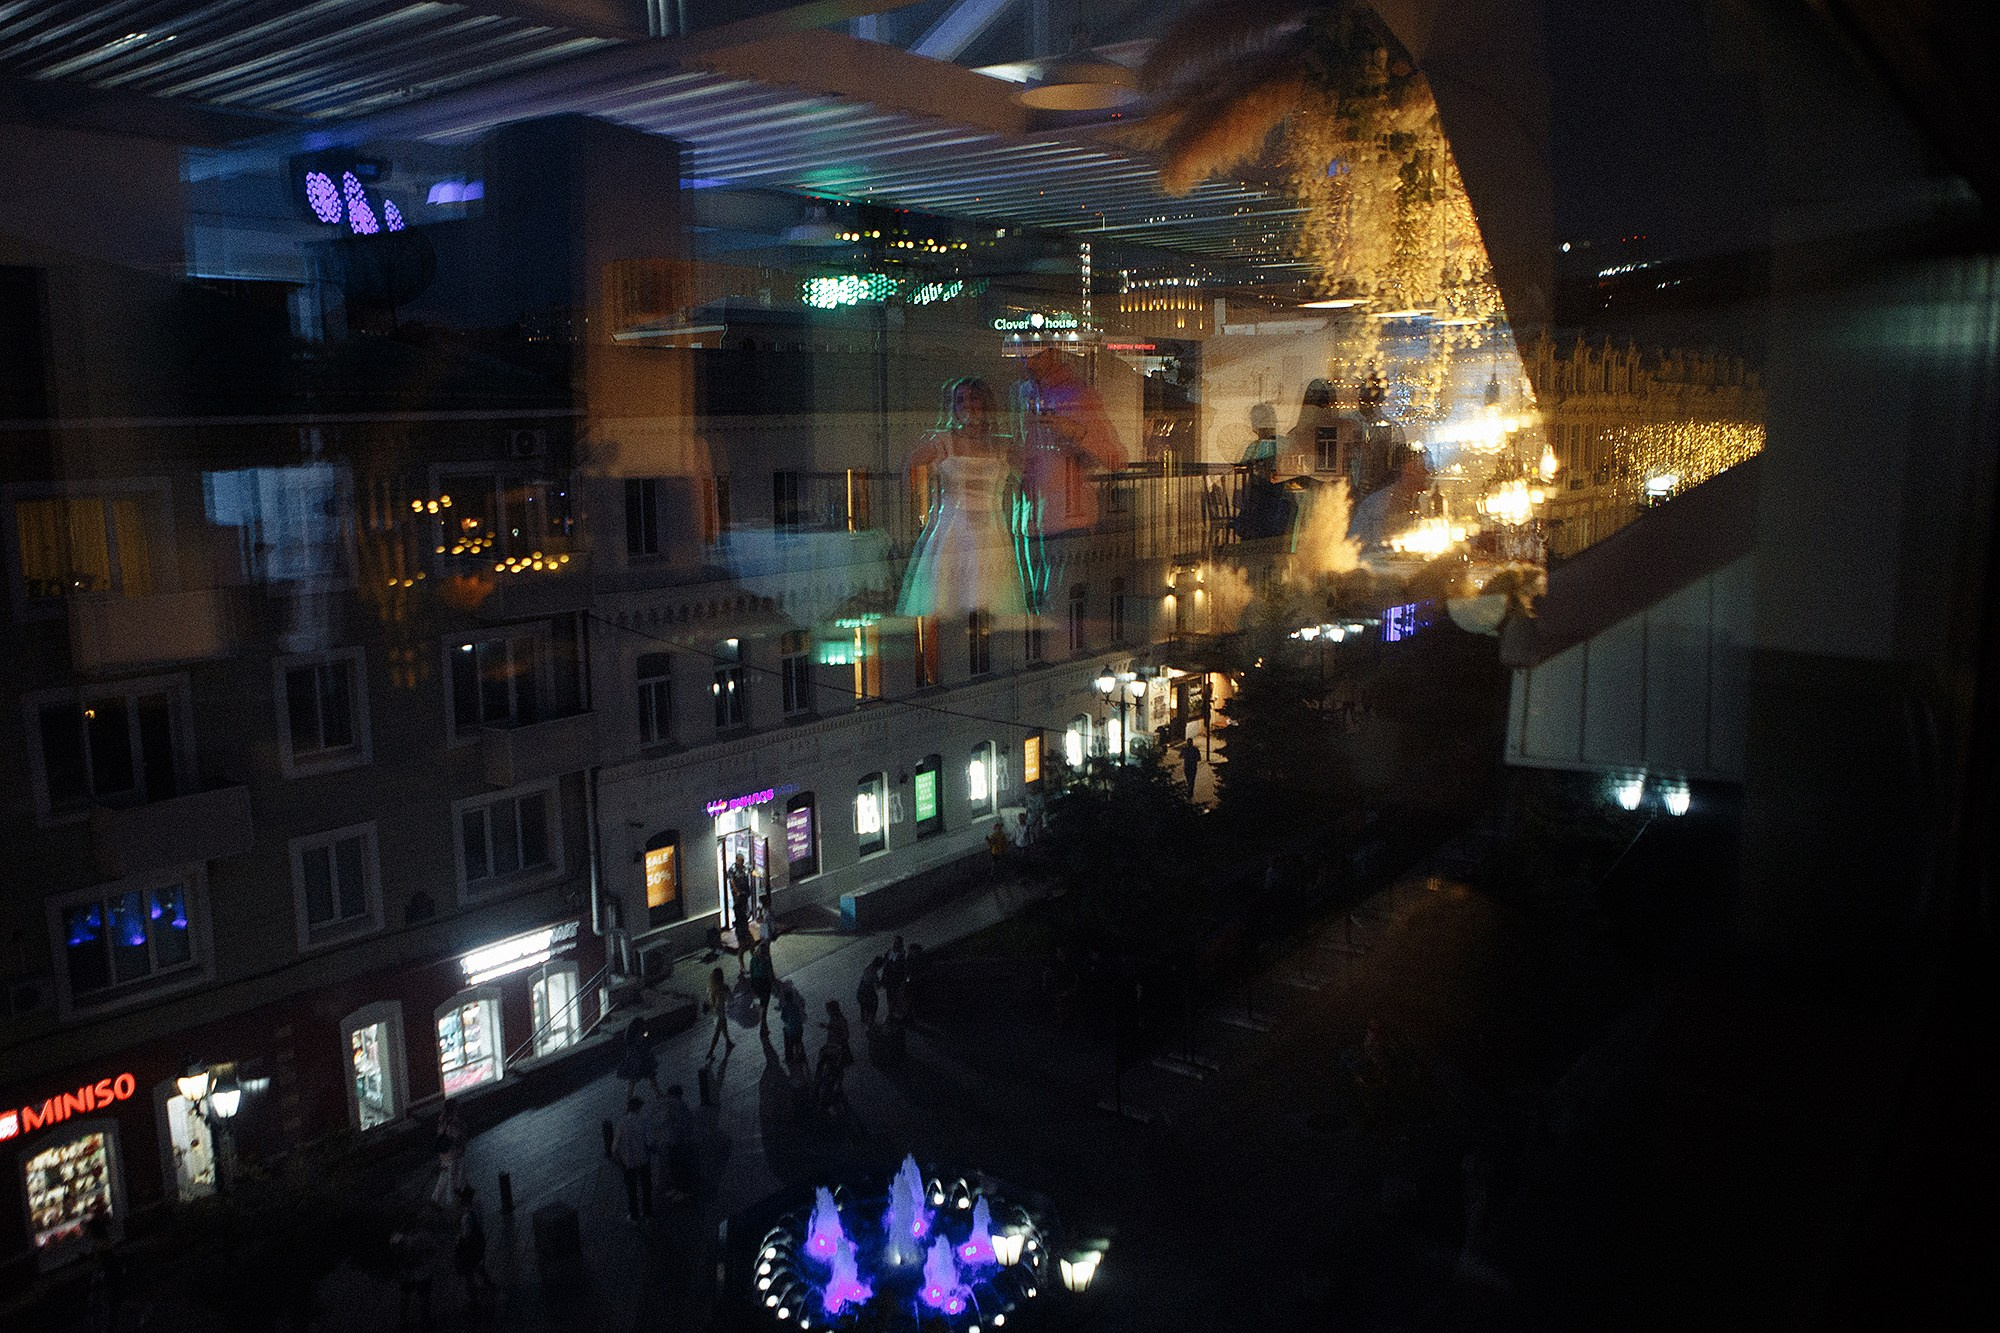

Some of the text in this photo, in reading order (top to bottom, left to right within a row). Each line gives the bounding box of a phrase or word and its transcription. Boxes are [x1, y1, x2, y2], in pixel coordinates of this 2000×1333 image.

[994, 316, 1078, 330] Clover house
[646, 852, 669, 869] SALE
[21, 1072, 136, 1135] MINISO
